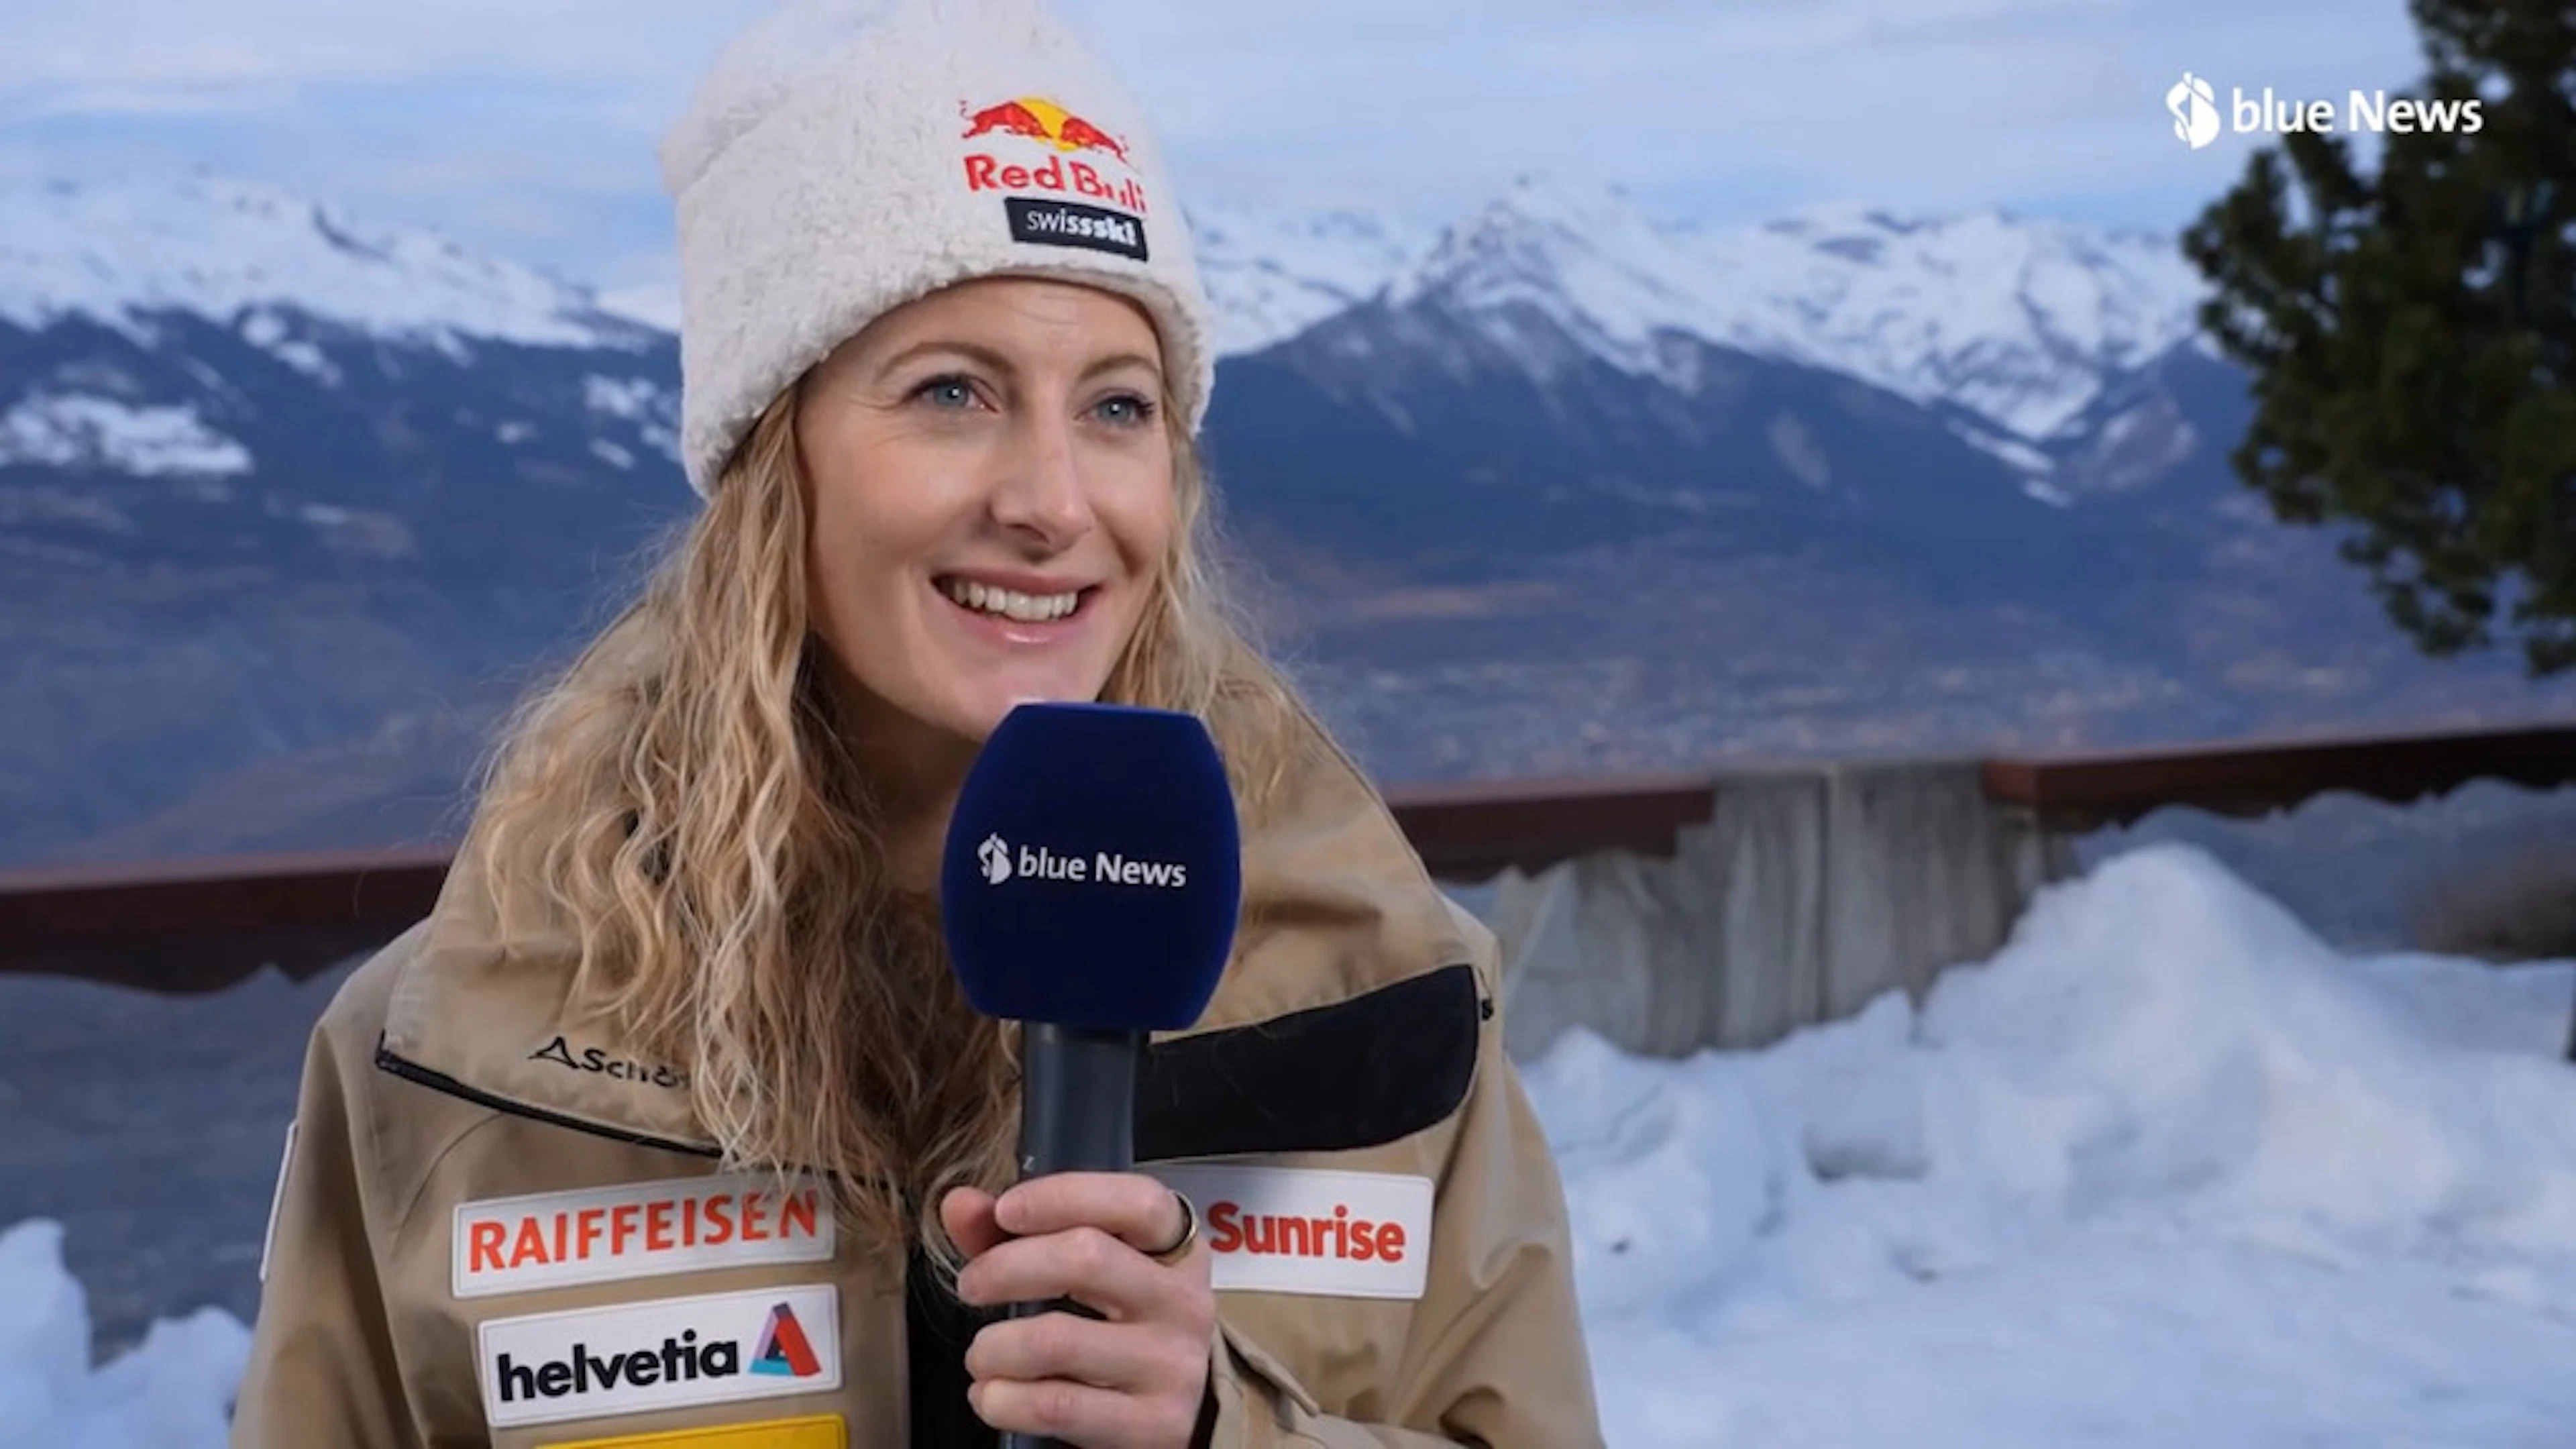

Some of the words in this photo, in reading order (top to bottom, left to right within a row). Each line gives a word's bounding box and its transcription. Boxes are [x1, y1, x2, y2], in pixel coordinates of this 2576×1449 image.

[964, 154, 1067, 192] Red
[1069, 160, 1146, 213] Bull
[1026, 208, 1136, 246] swissski
[1018, 844, 1087, 881] blue
[1094, 851, 1187, 888] News
[469, 1189, 818, 1273] RAIFFEISEN
[1208, 1200, 1406, 1263] Sunrise
[497, 1328, 739, 1402] helvetia
